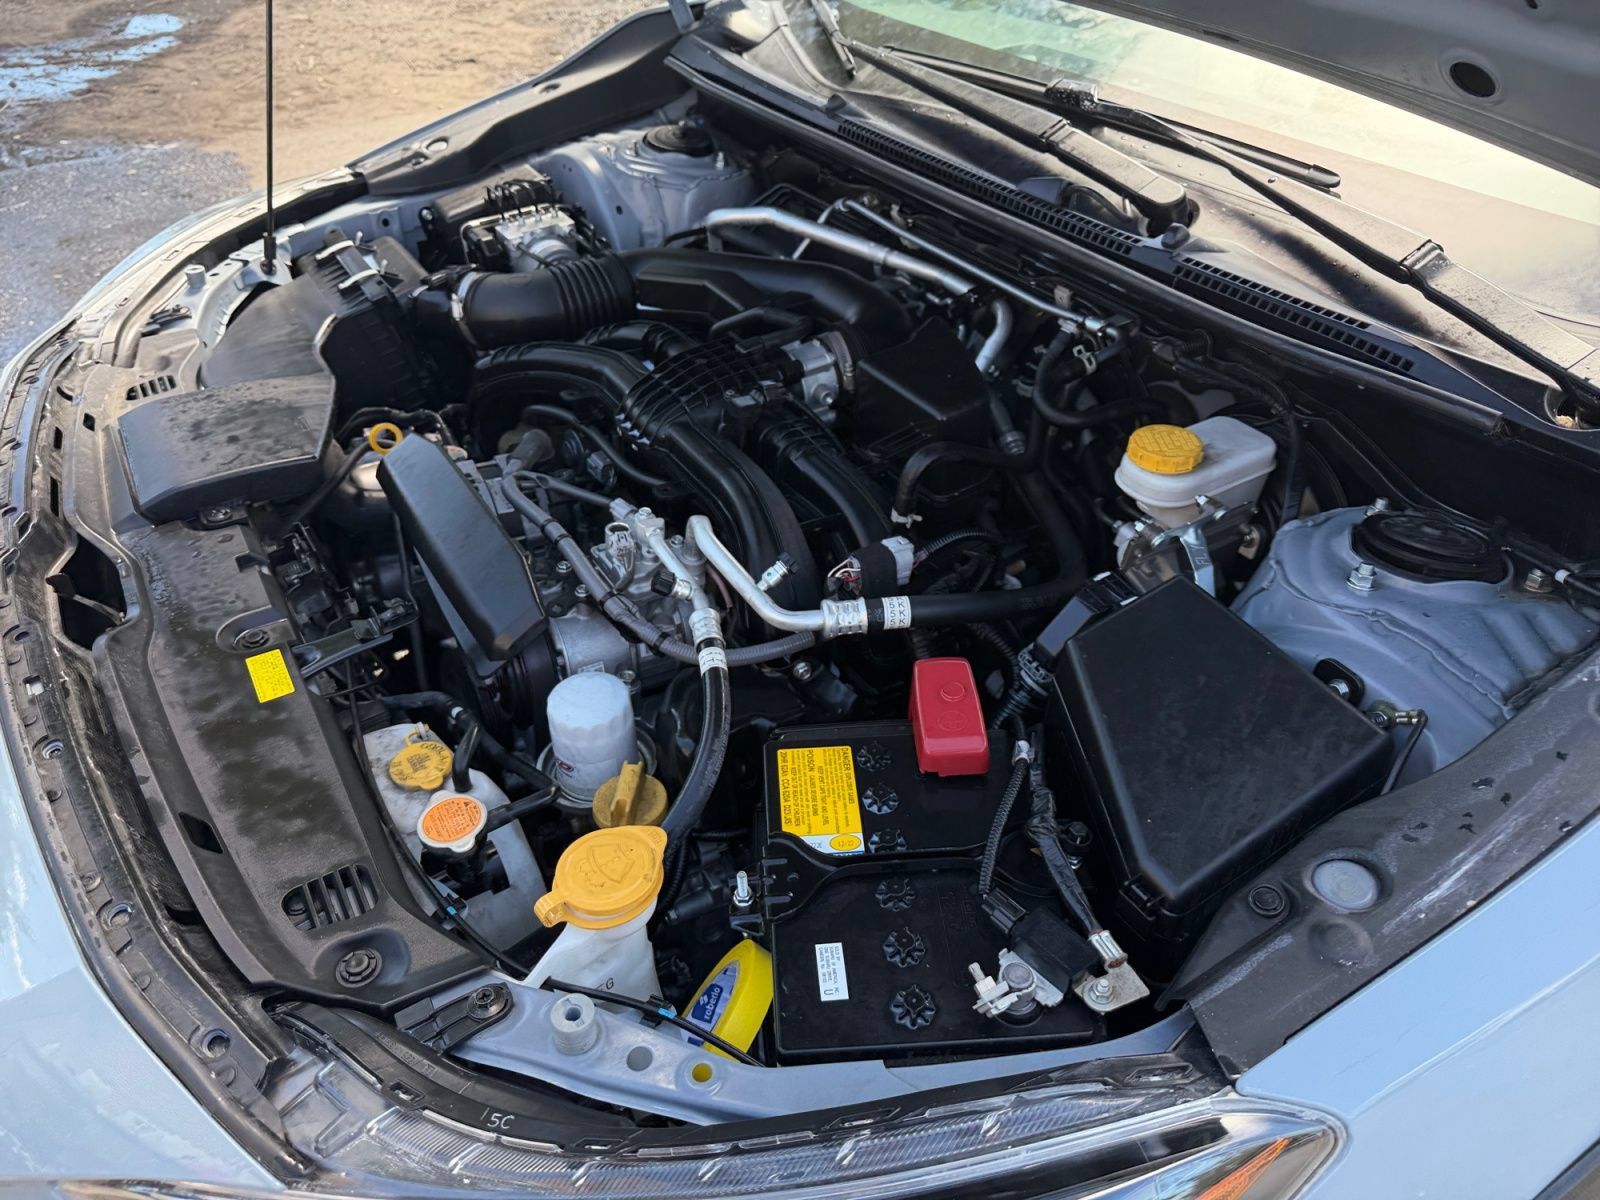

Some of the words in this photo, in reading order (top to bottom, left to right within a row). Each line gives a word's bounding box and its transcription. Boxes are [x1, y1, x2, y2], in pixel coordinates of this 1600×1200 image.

[807, 749, 815, 772] POISON
[842, 748, 850, 771] DANGER
[704, 987, 721, 1020] roberlo
